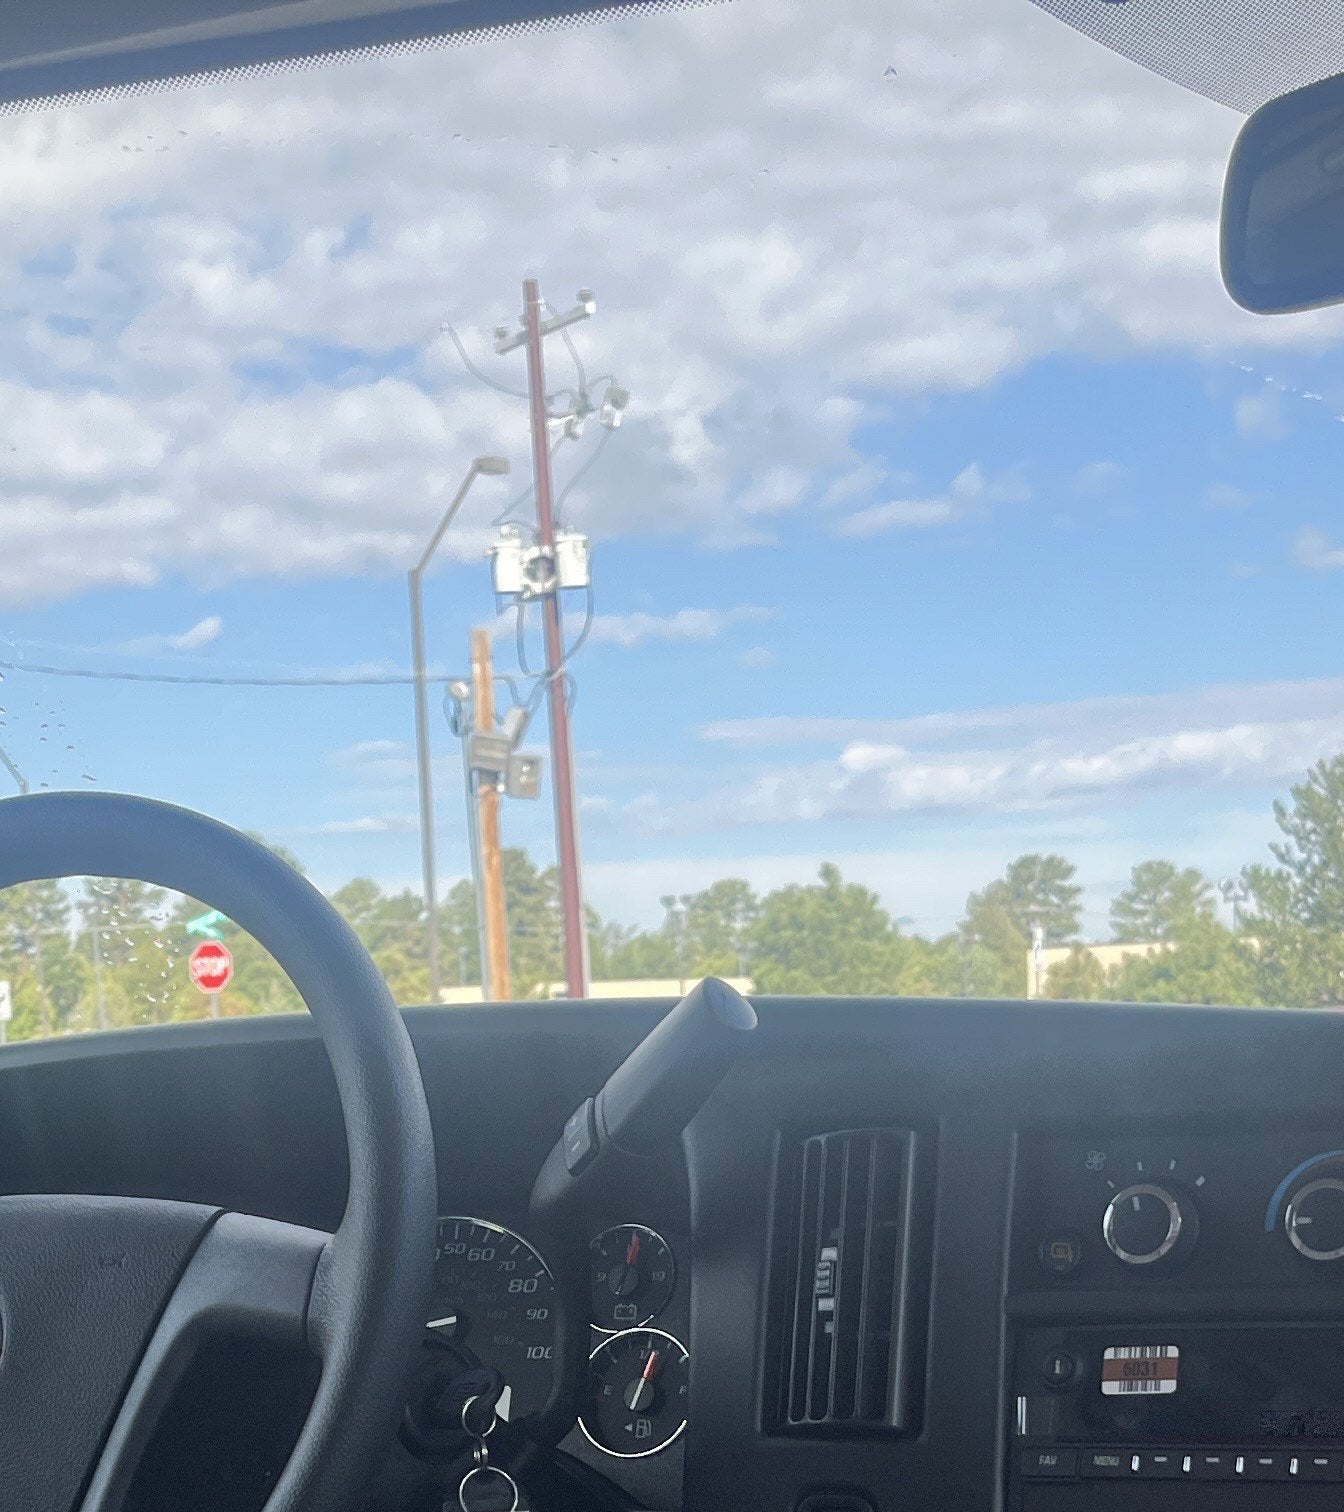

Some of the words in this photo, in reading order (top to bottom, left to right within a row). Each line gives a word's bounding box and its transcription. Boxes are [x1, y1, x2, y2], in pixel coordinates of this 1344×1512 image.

[443, 1242, 467, 1255] 50
[467, 1247, 495, 1262] 60
[507, 1278, 539, 1293] 80
[526, 1307, 549, 1320] 90
[1038, 1454, 1058, 1465] FAV
